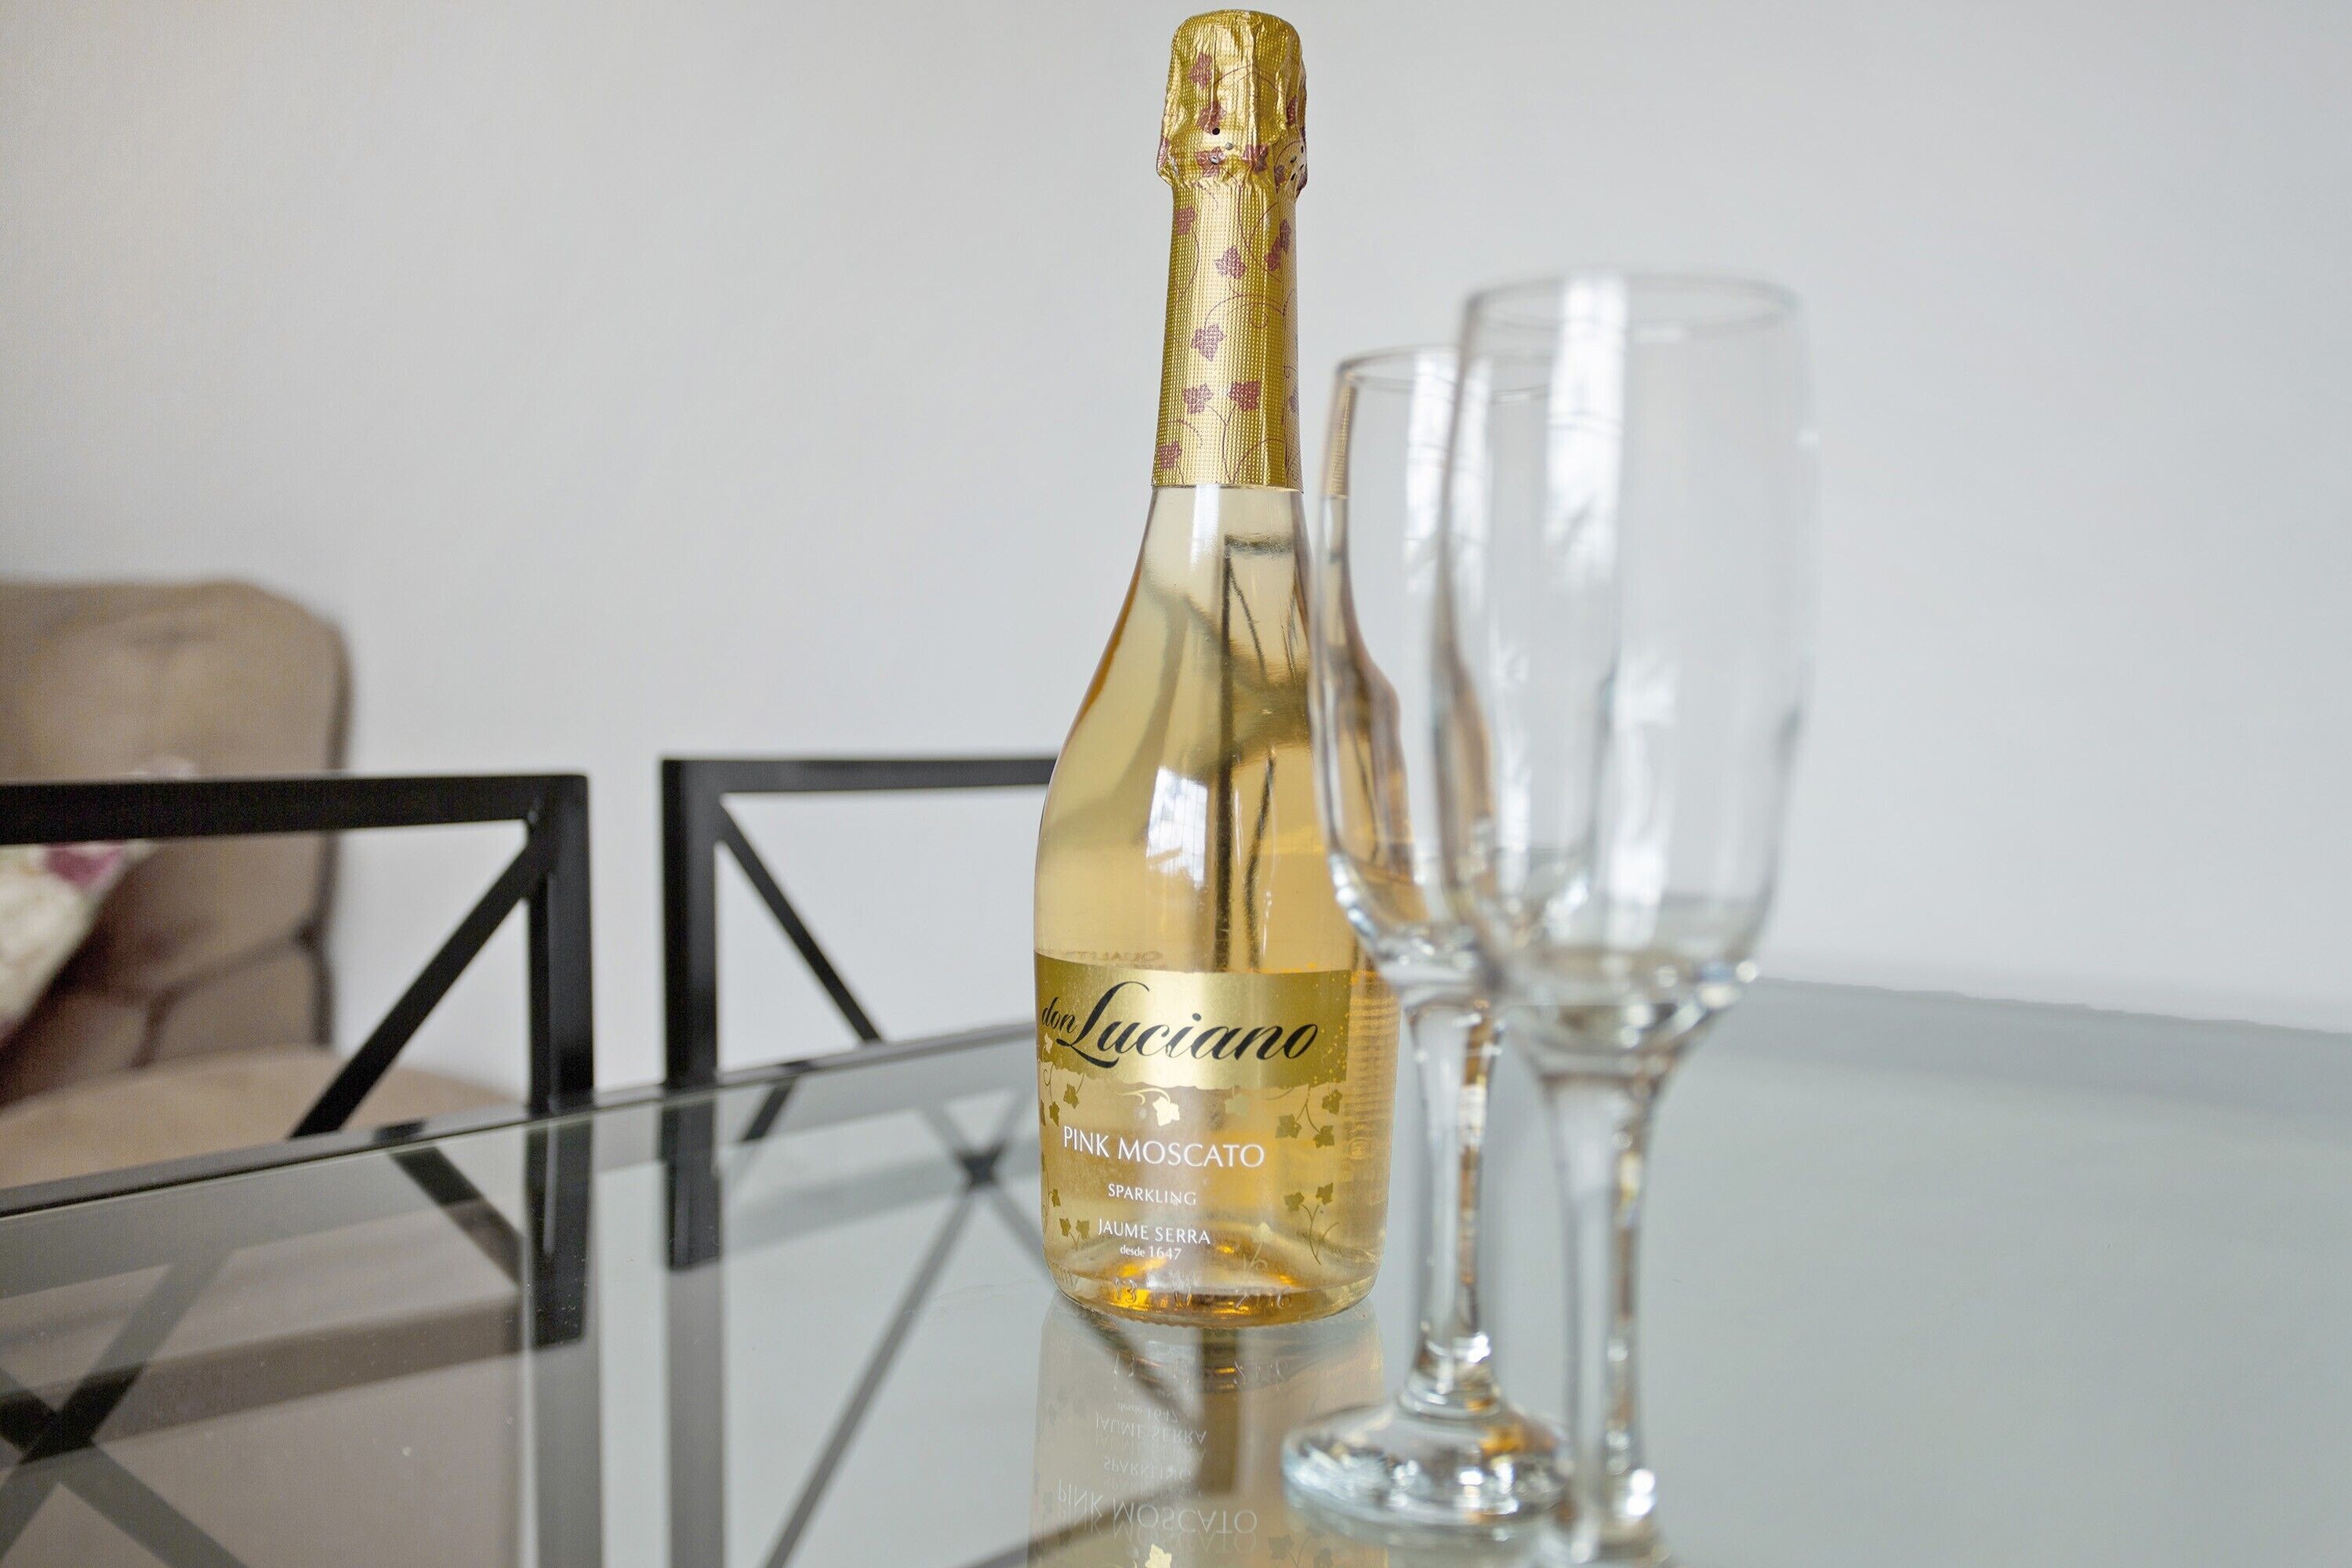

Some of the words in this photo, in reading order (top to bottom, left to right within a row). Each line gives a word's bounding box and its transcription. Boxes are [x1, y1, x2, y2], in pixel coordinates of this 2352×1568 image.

[1041, 996, 1077, 1034] don
[1055, 980, 1318, 1069] Luciano
[1063, 1126, 1110, 1158] PINK
[1117, 1137, 1265, 1168] MOSCATO
[1107, 1183, 1197, 1207] SPARKLING
[1098, 1218, 1149, 1241] JAUME
[1154, 1226, 1211, 1245] SERRA
[1120, 1244, 1145, 1258] desde
[1148, 1245, 1182, 1261] 1647
